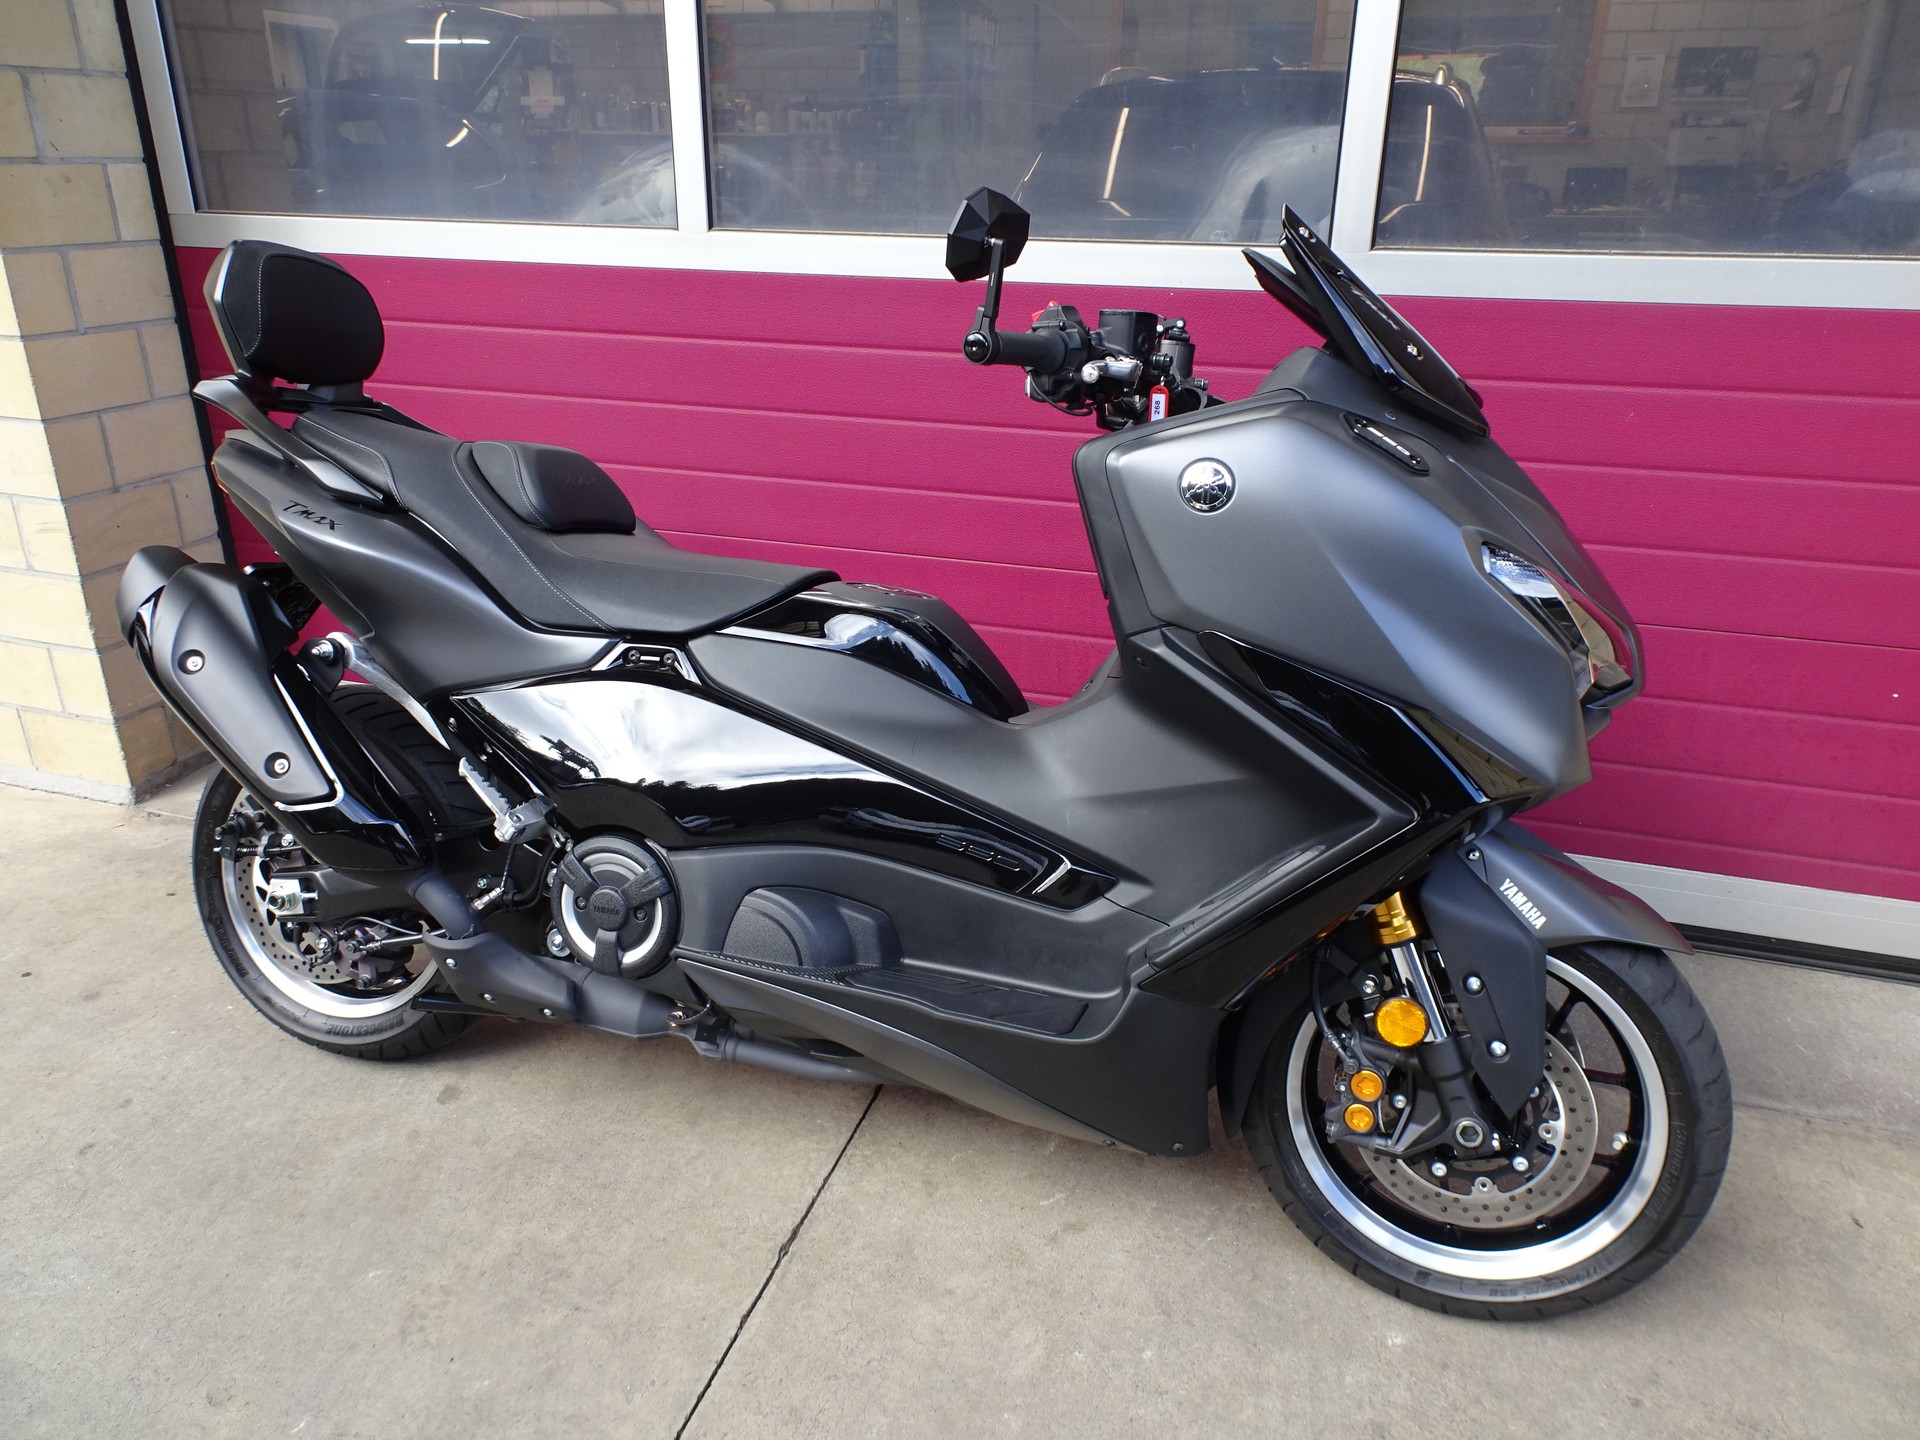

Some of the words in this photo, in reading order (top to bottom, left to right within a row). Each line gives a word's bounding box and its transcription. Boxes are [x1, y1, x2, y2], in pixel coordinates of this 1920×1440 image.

[282, 499, 343, 531] TMAX
[593, 904, 620, 916] YAMAHA
[1499, 877, 1547, 930] YAMAHA
